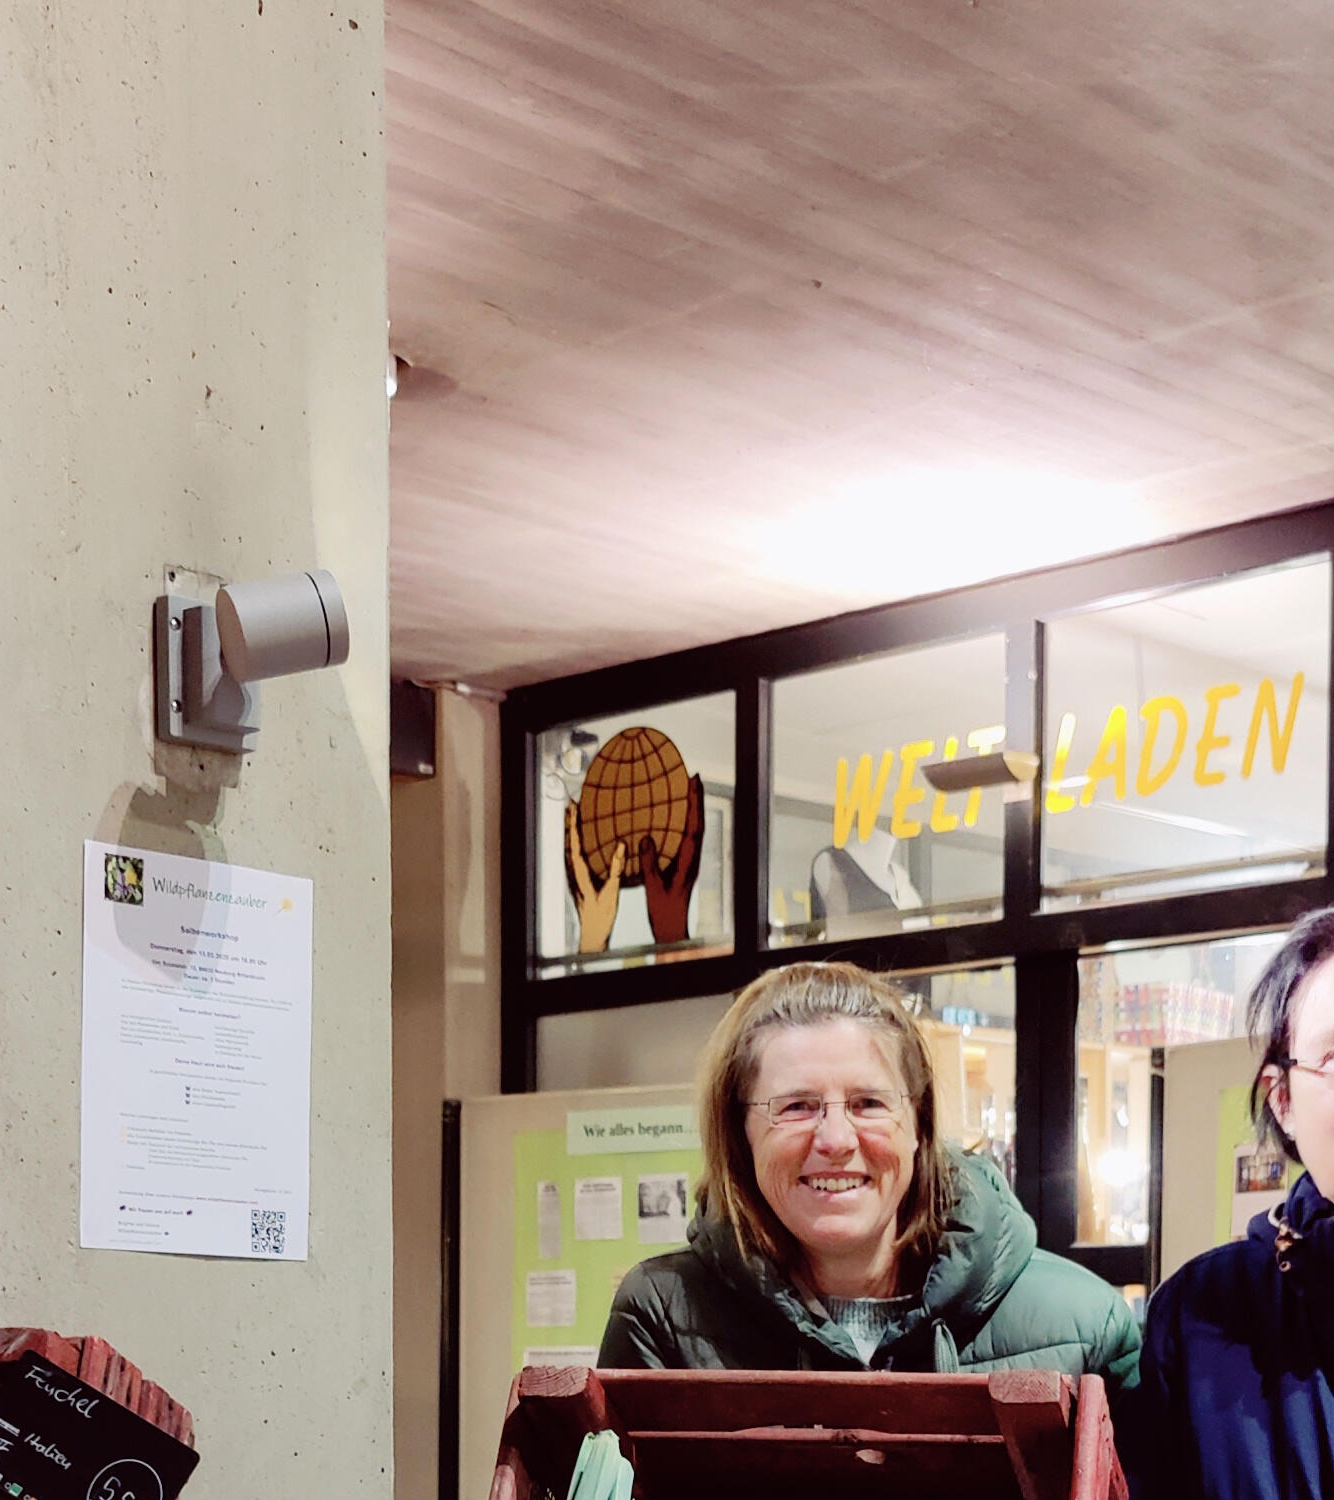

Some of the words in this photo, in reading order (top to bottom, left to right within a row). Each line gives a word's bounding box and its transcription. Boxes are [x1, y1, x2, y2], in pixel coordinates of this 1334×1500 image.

[833, 724, 1007, 848] WELT
[1045, 672, 1304, 814] LADEN
[152, 876, 268, 910] Wildpflanzenzauber
[583, 1124, 605, 1137] Wie
[609, 1123, 635, 1137] alles
